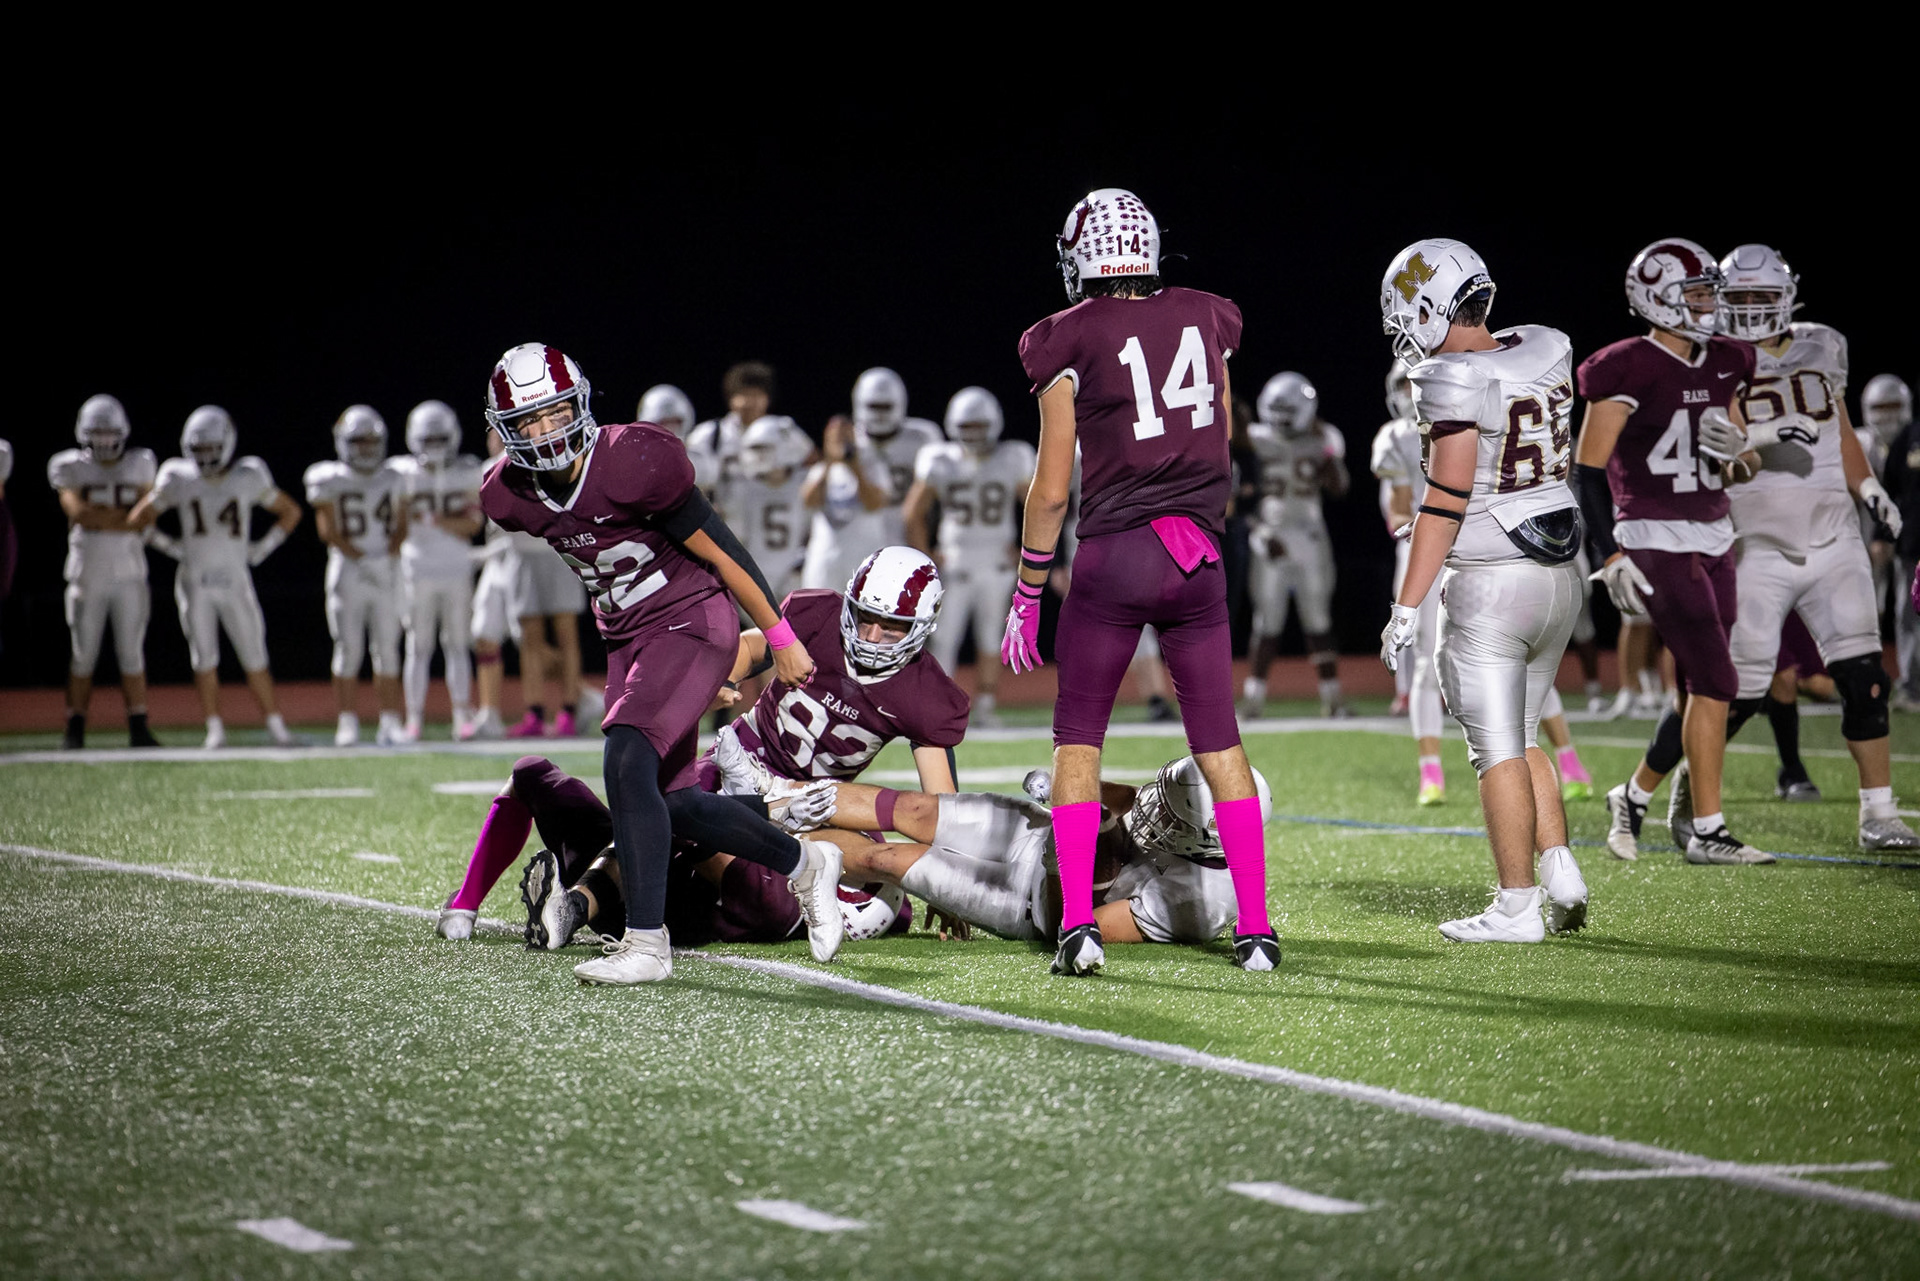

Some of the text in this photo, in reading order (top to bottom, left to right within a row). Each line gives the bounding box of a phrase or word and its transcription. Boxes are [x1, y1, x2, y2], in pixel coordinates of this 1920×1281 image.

[1100, 263, 1150, 275] Riddell
[1391, 251, 1437, 305] M
[1117, 325, 1215, 441] 14
[521, 389, 549, 403] Riddell
[1682, 389, 1711, 403] RAMS
[190, 499, 242, 537] 14
[560, 532, 597, 549] RAMS
[821, 691, 860, 721] RAMS
